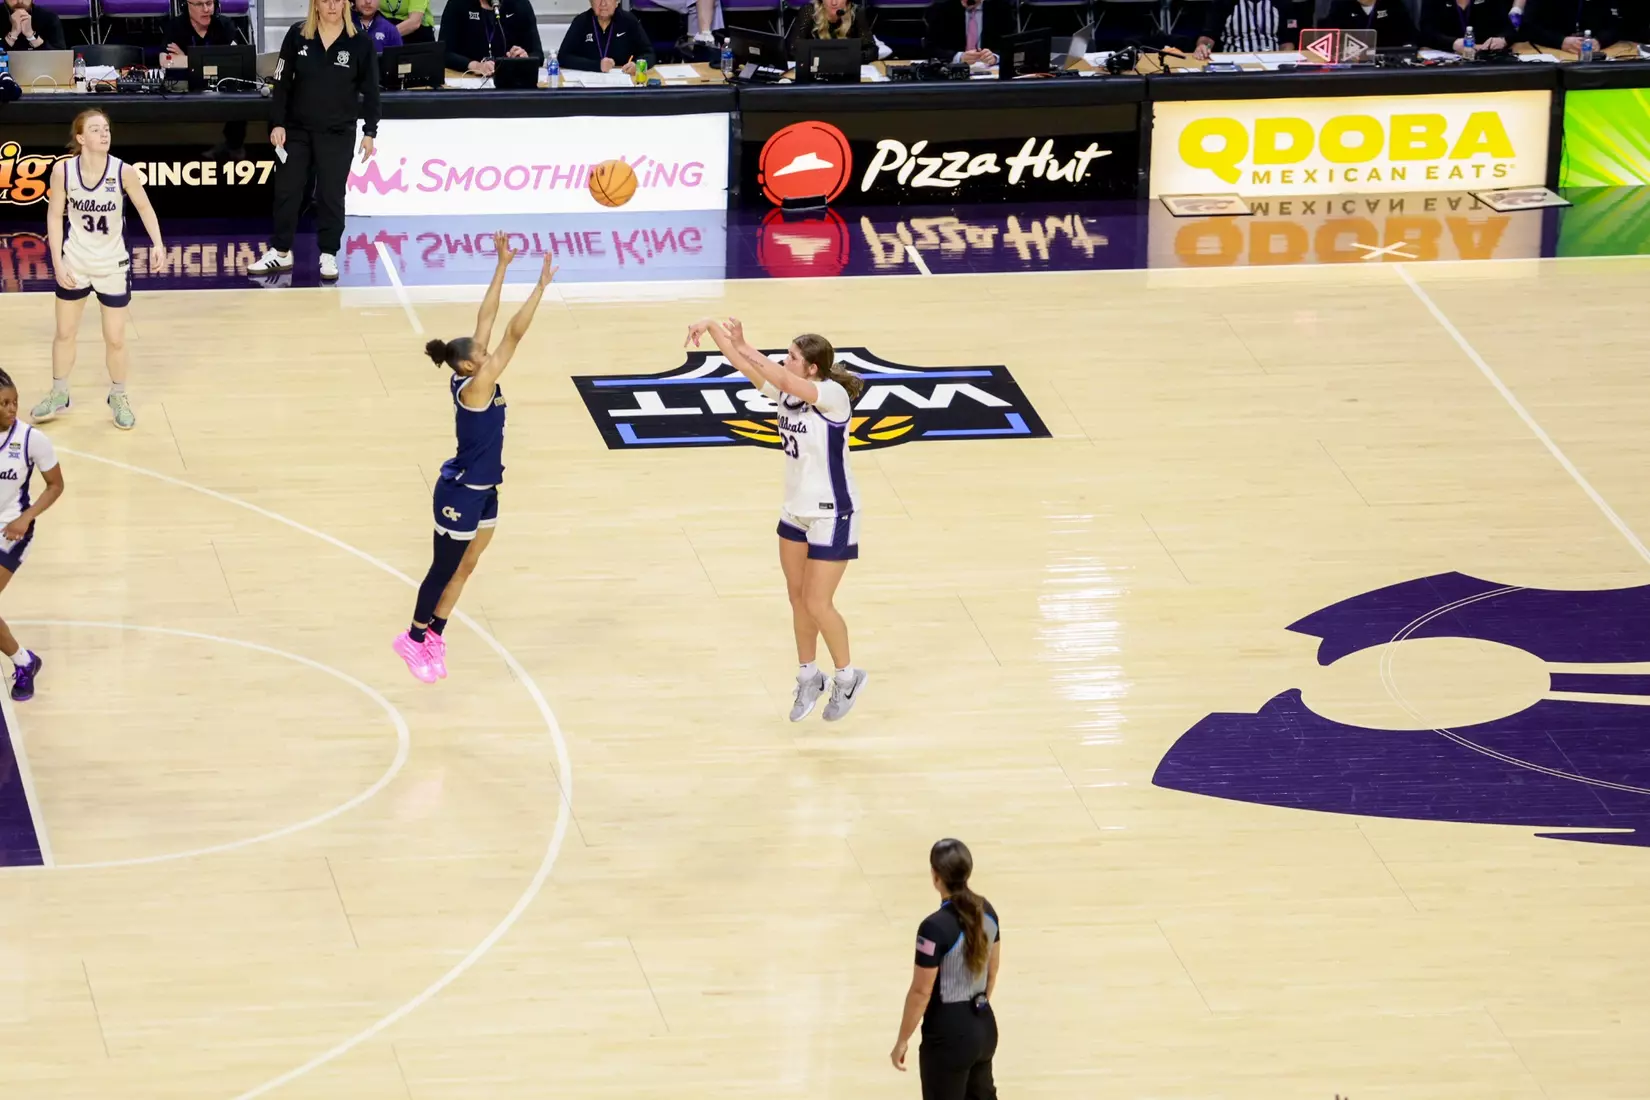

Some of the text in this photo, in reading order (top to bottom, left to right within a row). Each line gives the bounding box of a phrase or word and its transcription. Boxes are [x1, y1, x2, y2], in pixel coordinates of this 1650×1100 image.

[1178, 111, 1516, 184] QDOBA
[132, 160, 277, 186] SINCE 197
[861, 137, 1113, 192] Pizza Hut
[1251, 163, 1509, 184] MEXICAN EATS
[69, 197, 117, 213] Wildcats
[81, 214, 109, 235] 34
[778, 416, 807, 433] ldcats
[780, 432, 799, 459] 23
